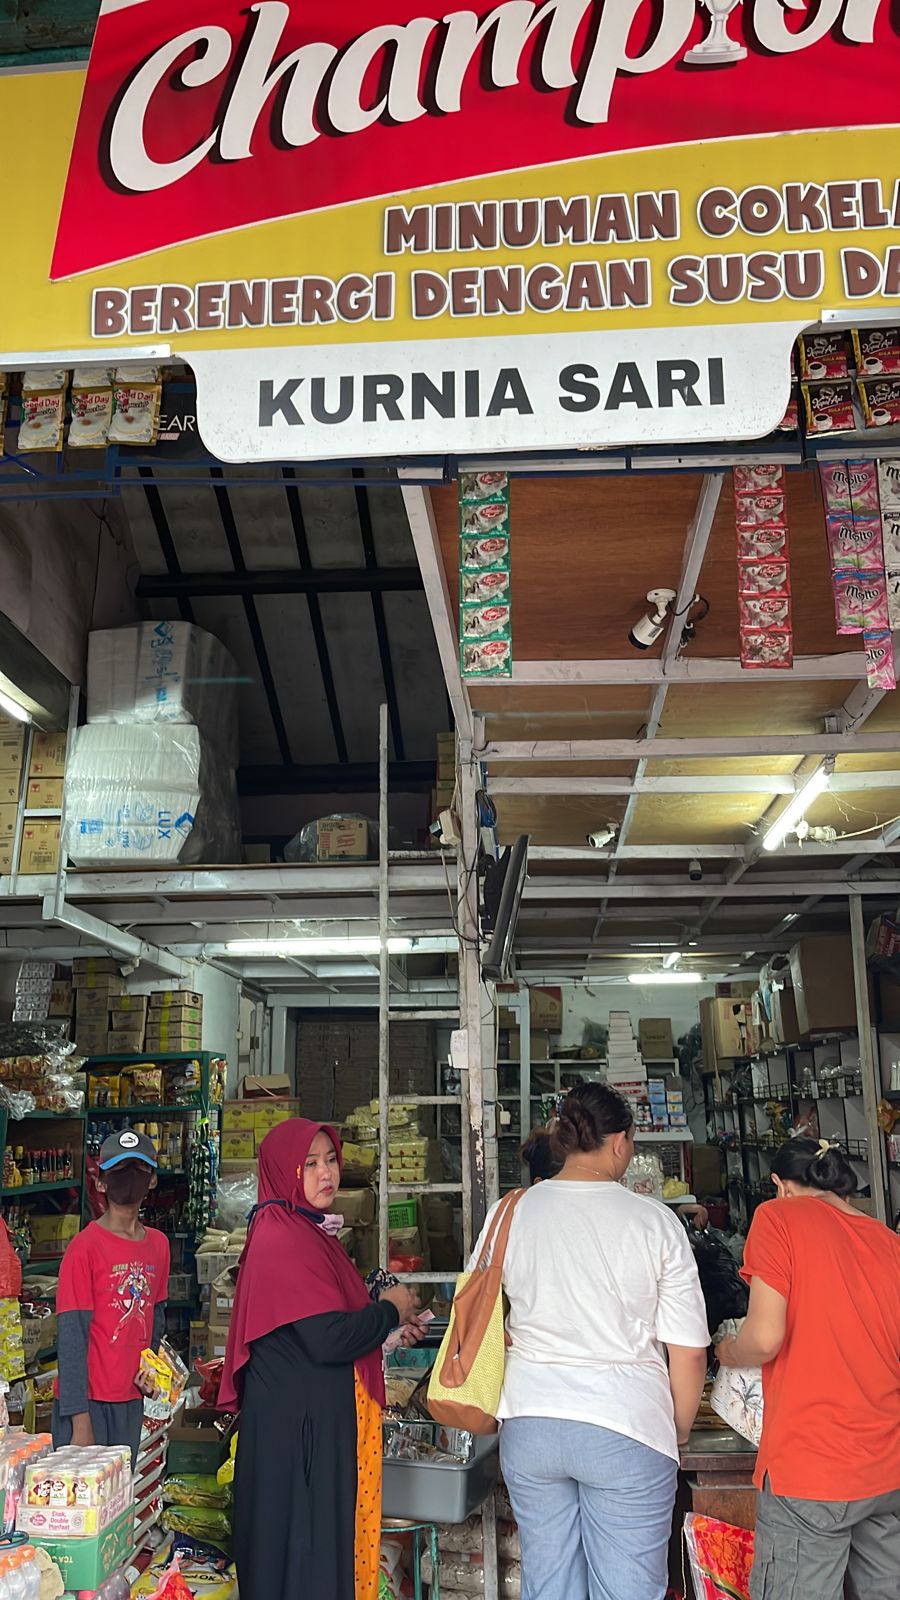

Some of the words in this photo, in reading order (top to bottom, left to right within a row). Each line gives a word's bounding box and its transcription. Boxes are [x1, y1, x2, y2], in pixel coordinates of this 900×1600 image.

[384, 190, 681, 255] MINUMAN
[697, 179, 900, 238] COKEL
[91, 271, 396, 338] BERENERGI
[411, 257, 652, 319] DENGAN
[668, 249, 825, 307] SUSU
[94, 395, 110, 404] Day
[137, 391, 154, 401] Day
[258, 368, 534, 428] KURNIA
[558, 357, 726, 413] SARI
[45, 398, 60, 409] Day
[832, 471, 869, 485] Molto
[839, 527, 873, 542] Molto
[845, 585, 879, 601] Molto
[158, 810, 171, 840] LUX
